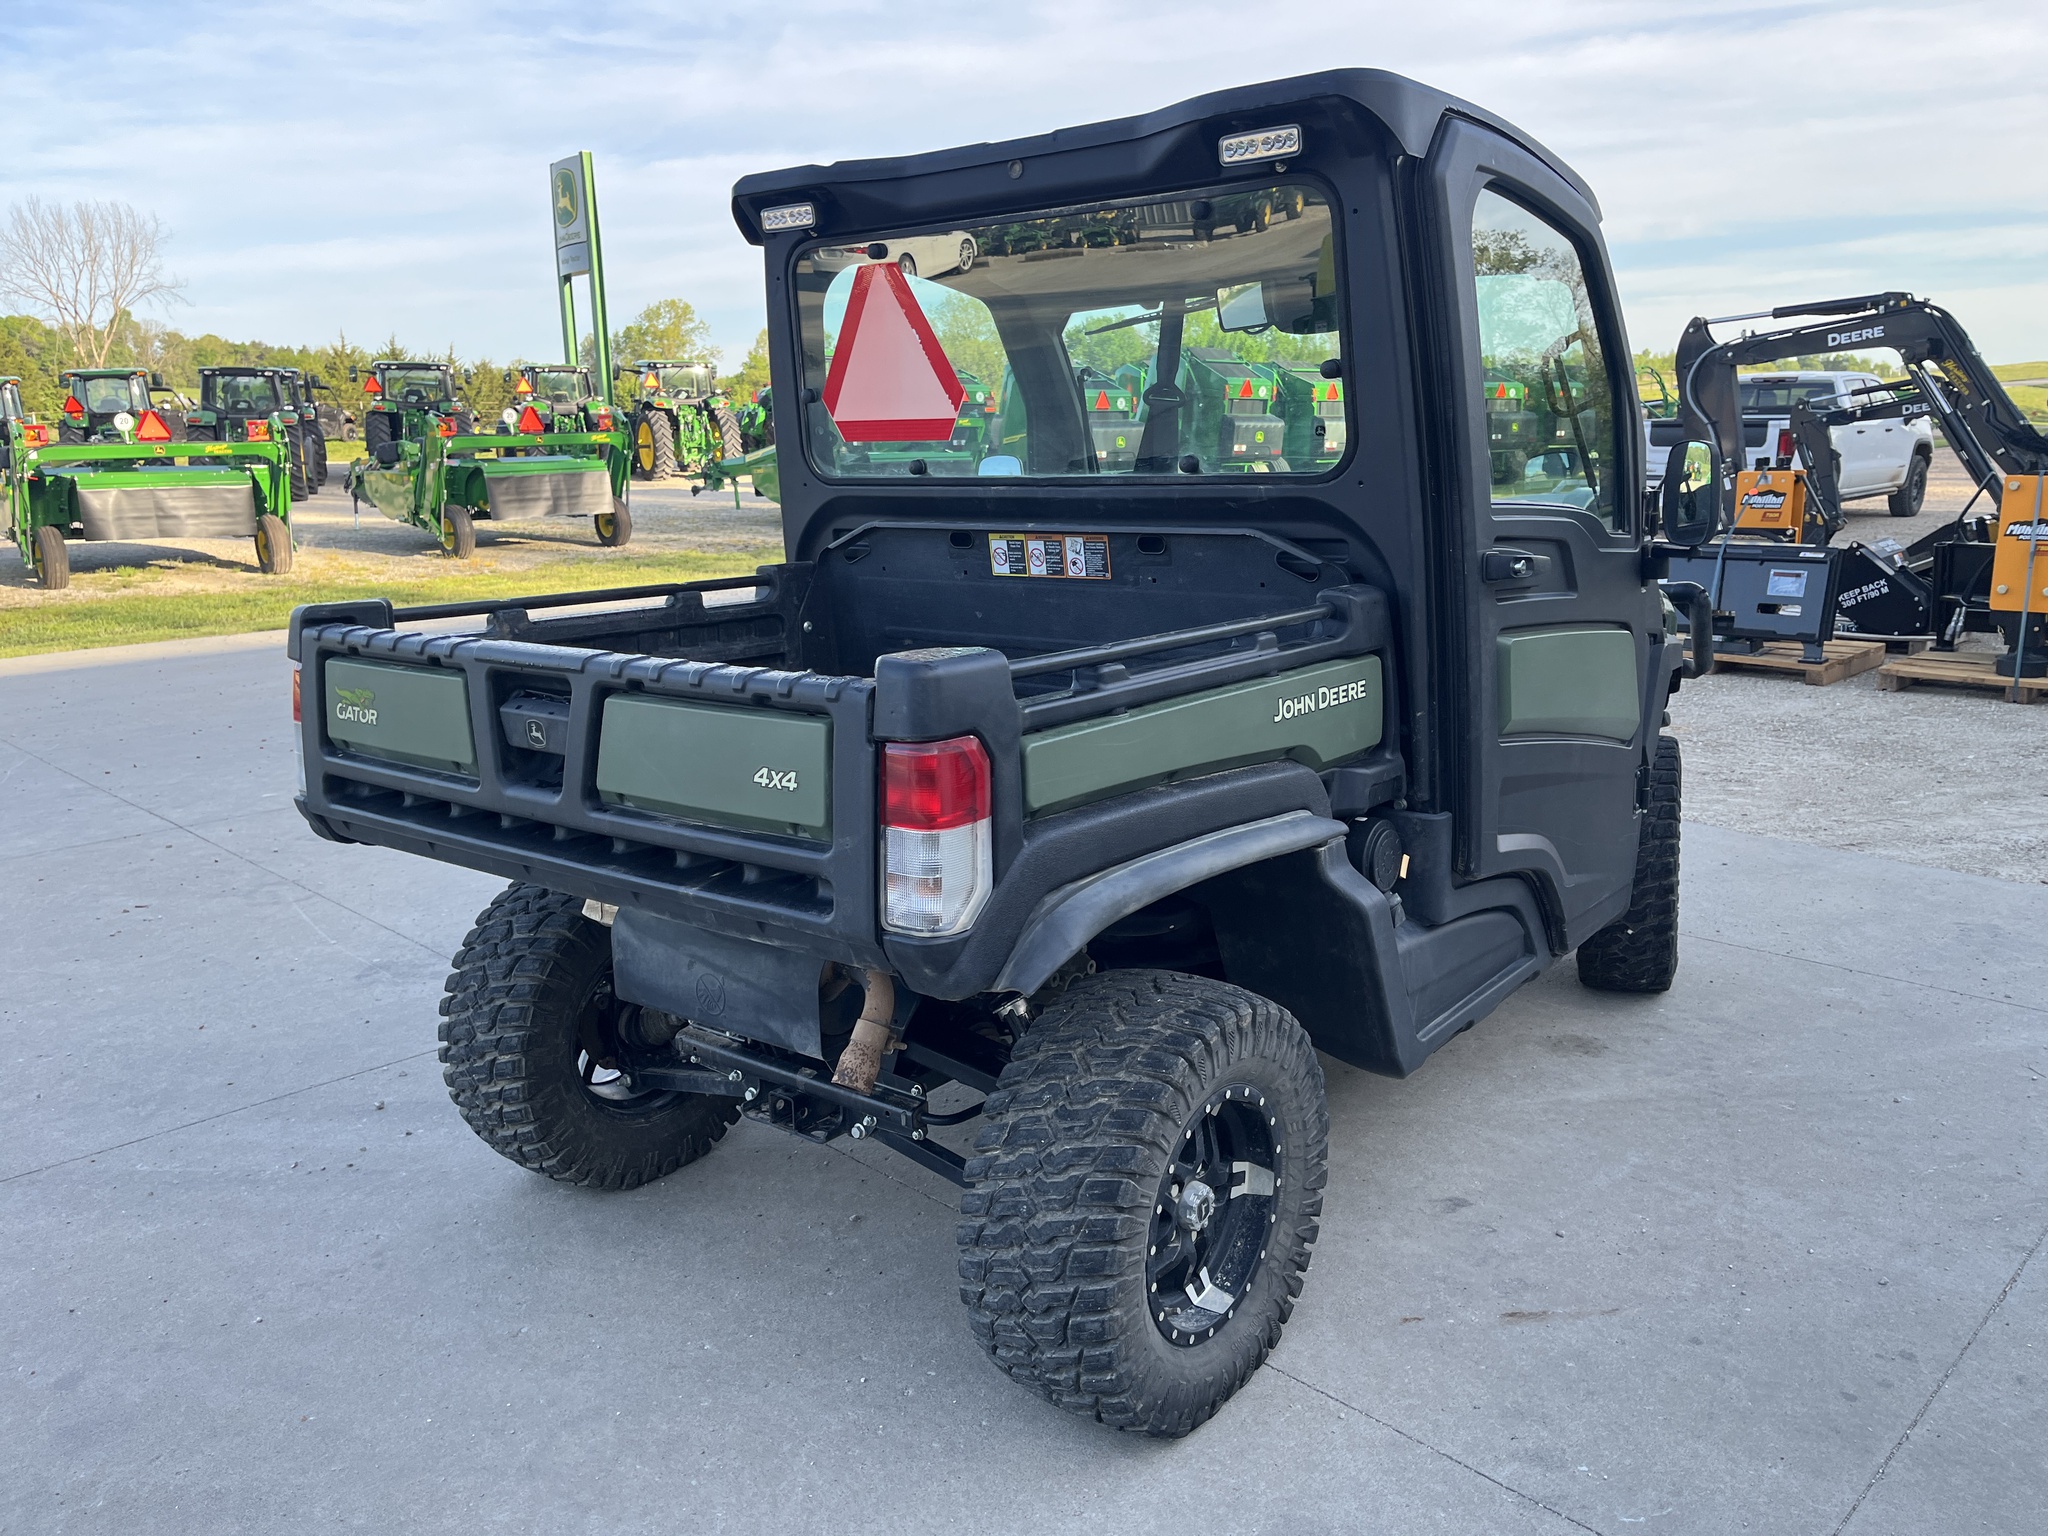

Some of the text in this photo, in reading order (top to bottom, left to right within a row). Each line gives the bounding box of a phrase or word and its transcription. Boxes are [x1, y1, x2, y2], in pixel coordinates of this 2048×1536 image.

[1827, 325, 1885, 347] DEERE
[1901, 402, 1931, 415] DEE
[119, 417, 129, 425] 20
[1838, 578, 1888, 602] KEEP BACK
[1840, 585, 1890, 609] 300 FT/90 M
[1273, 679, 1367, 723] JOHN DEERE
[336, 702, 378, 725] GATOR
